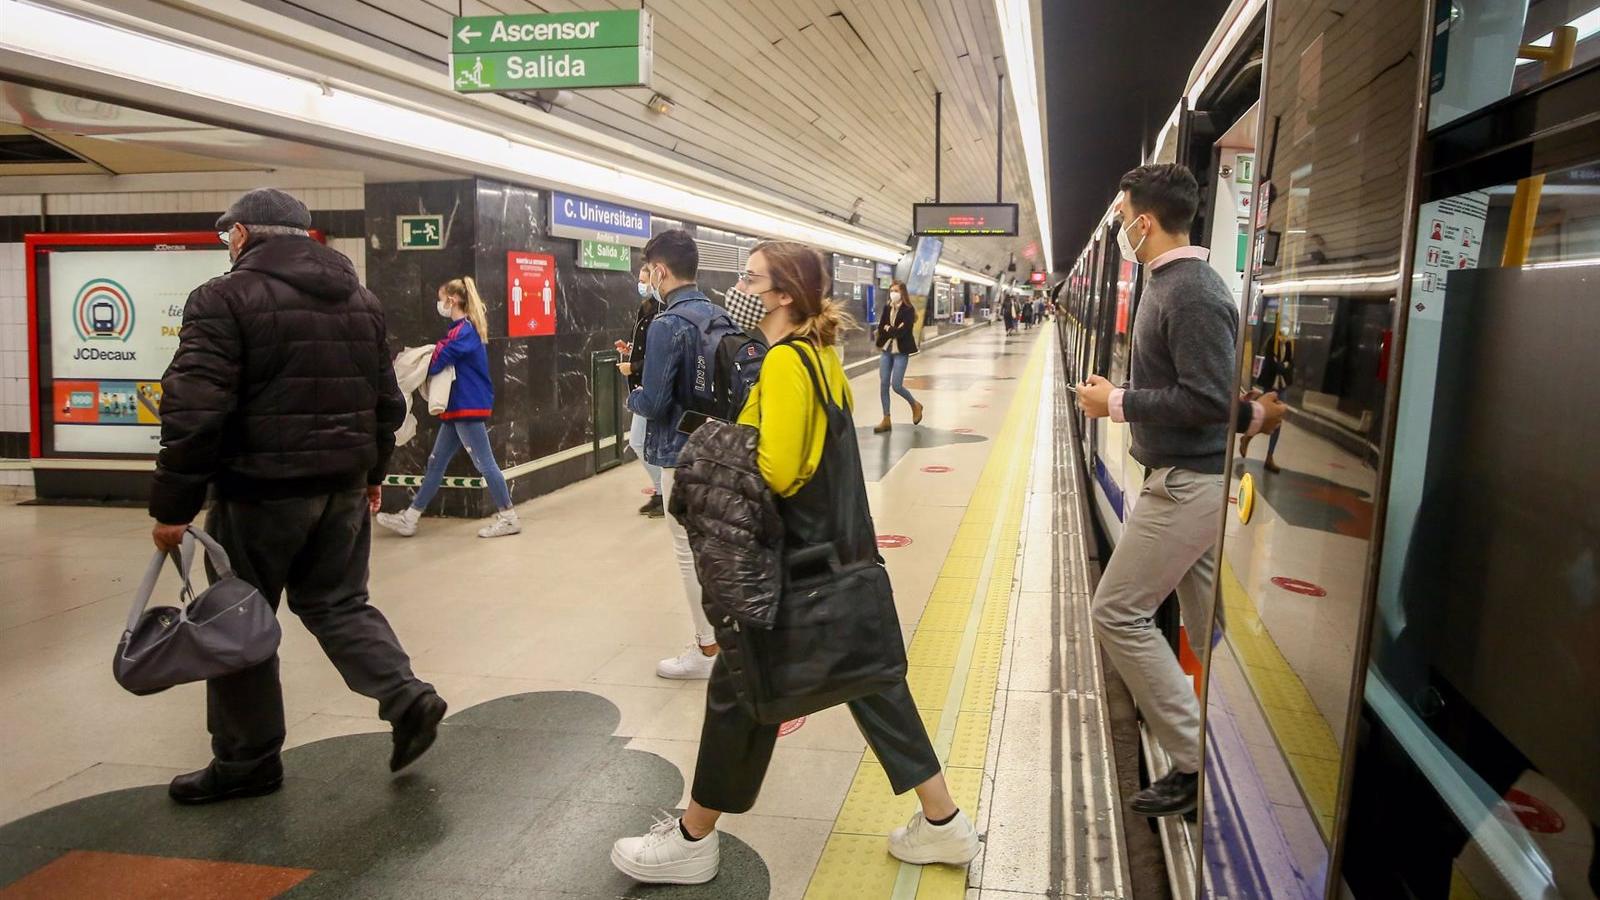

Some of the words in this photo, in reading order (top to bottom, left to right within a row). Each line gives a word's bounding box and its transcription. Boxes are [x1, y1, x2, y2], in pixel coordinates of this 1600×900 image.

[489, 20, 600, 43] Ascensor
[506, 54, 586, 80] Salida
[564, 198, 577, 219] C.
[579, 201, 643, 230] Universitaria
[597, 243, 618, 258] Salida
[73, 347, 137, 361] JCDecaux
